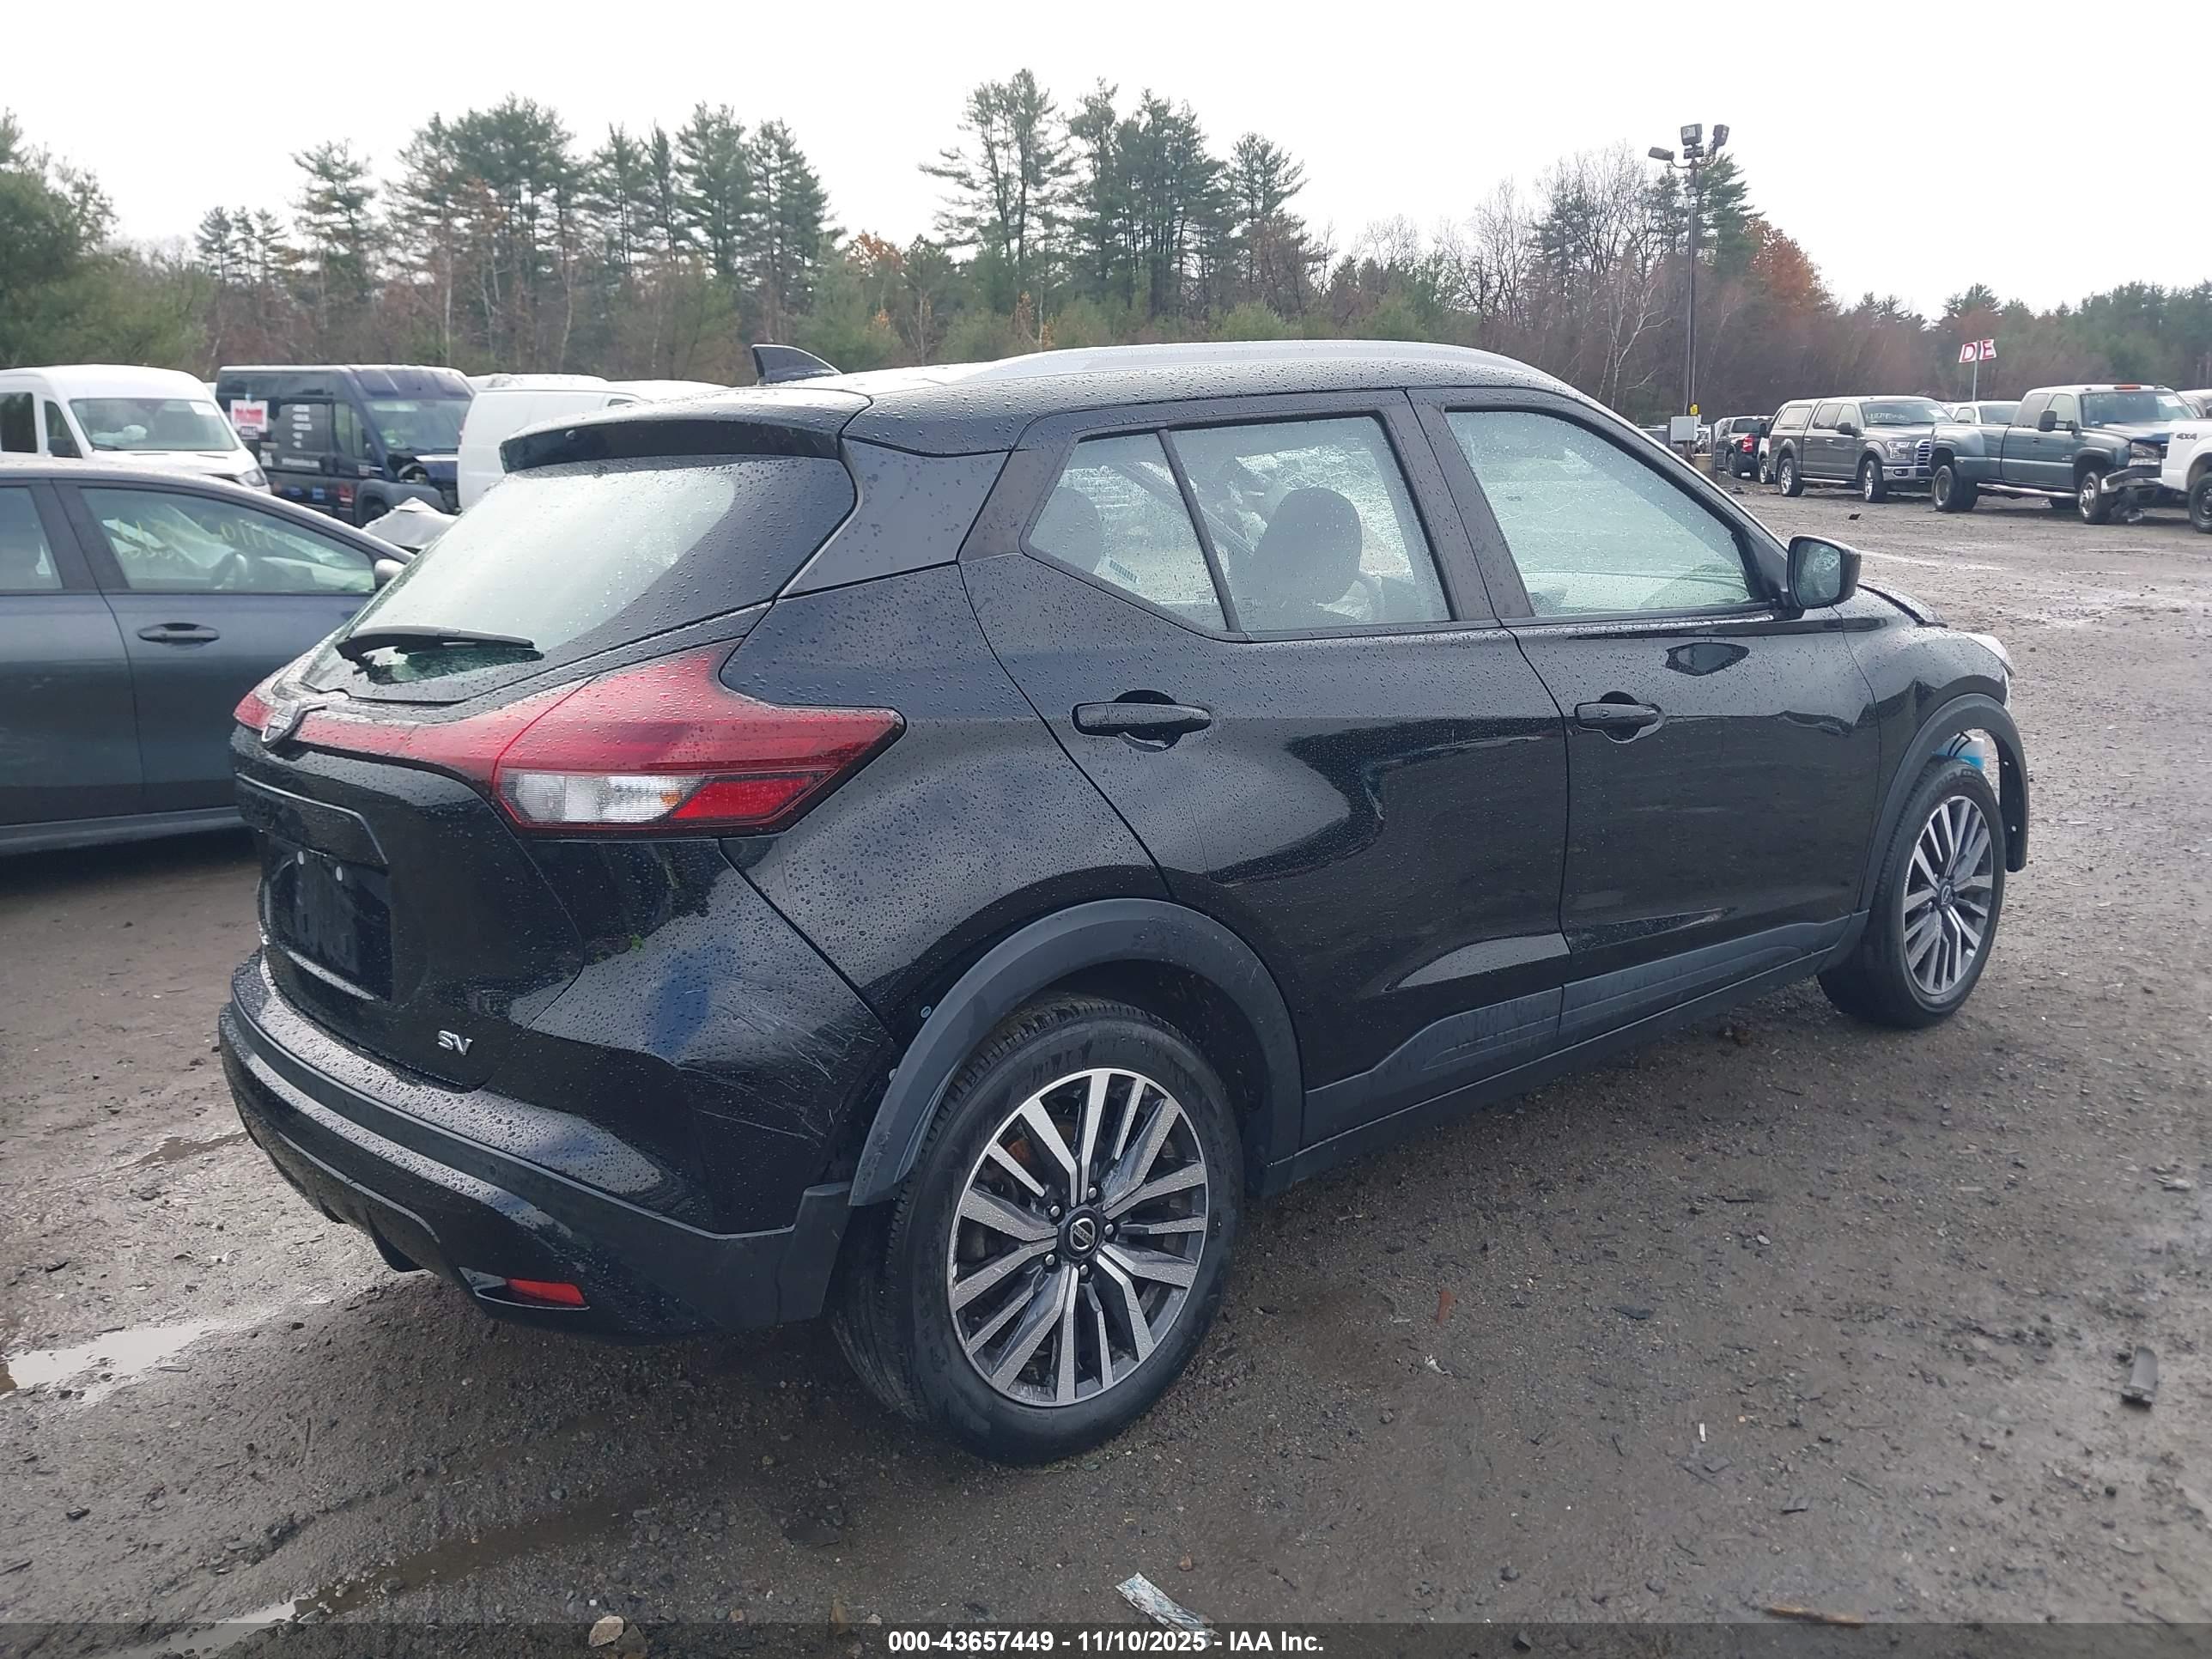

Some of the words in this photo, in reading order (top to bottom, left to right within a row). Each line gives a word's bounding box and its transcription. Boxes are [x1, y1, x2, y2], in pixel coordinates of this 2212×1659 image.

[1961, 343, 1976, 362] D
[1982, 340, 1996, 358] E
[437, 1030, 473, 1055] SV
